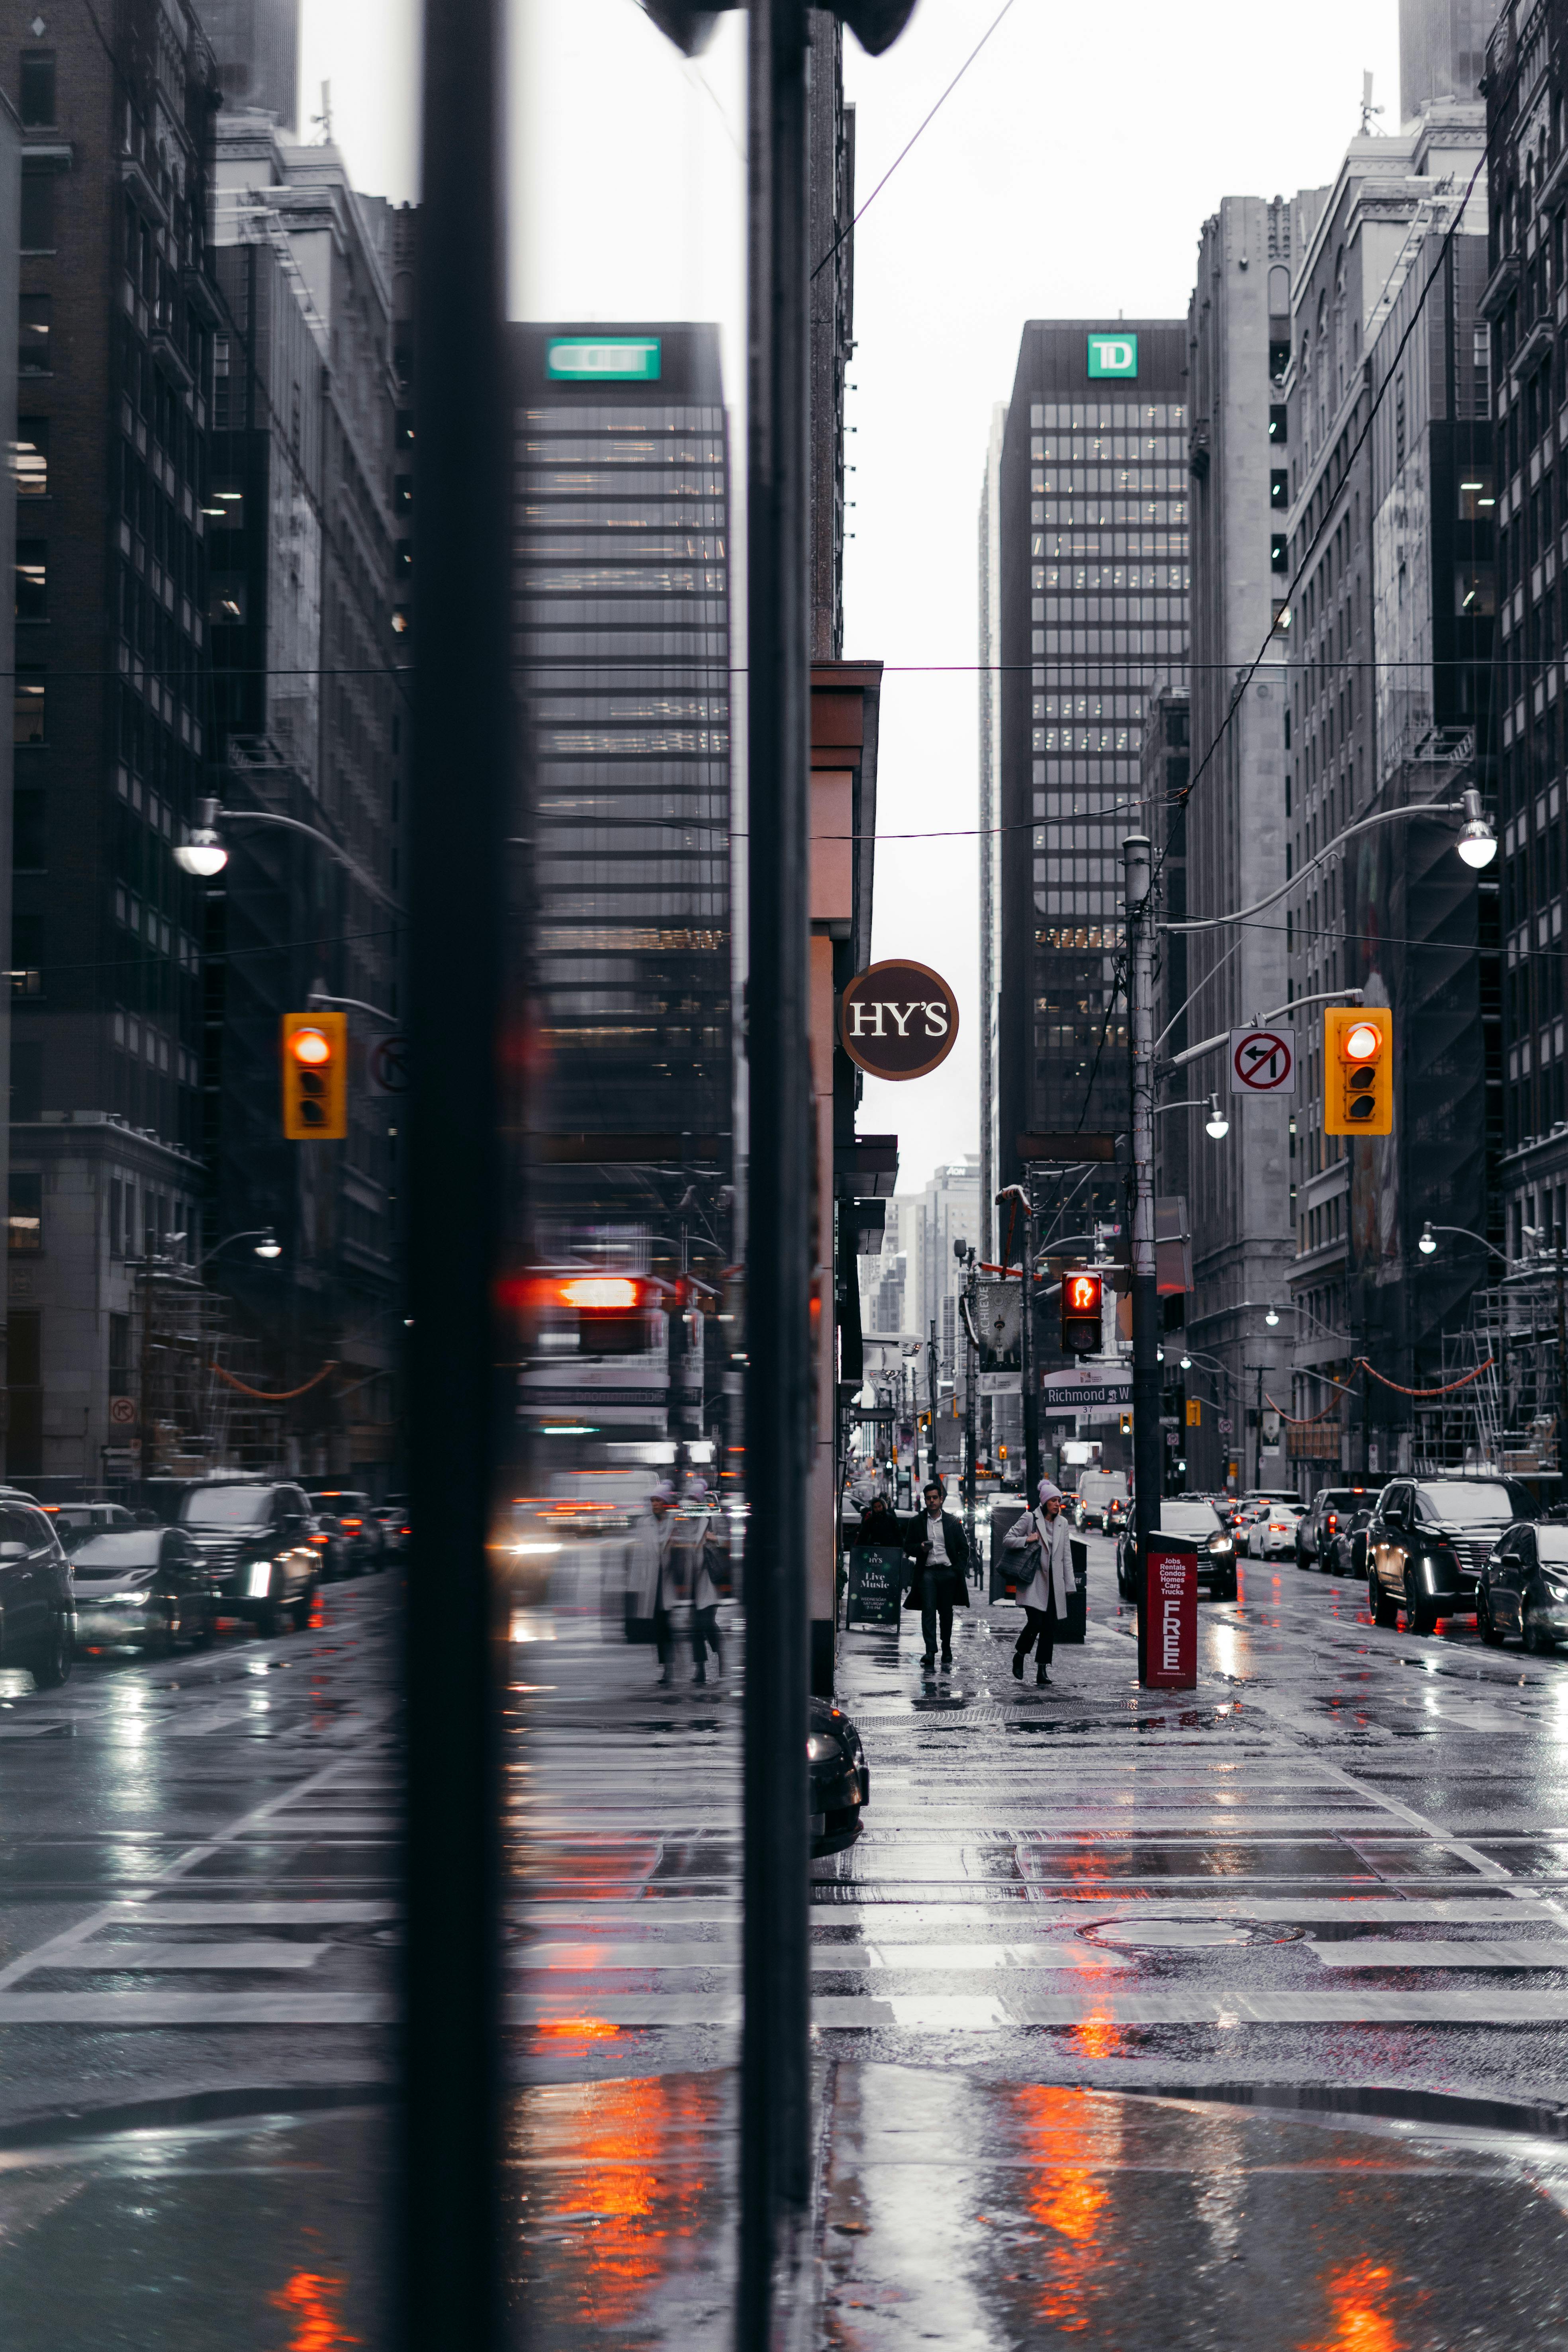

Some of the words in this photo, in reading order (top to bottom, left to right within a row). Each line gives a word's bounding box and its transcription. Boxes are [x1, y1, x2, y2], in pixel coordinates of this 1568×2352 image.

[1092, 342, 1133, 369] TD
[850, 1001, 947, 1036] HY'S
[979, 1286, 990, 1336] ACHIEVE
[1048, 1388, 1105, 1402] Richmond
[1119, 1387, 1129, 1400] W
[861, 1580, 889, 1588] Music
[865, 1572, 885, 1580] Live
[1163, 1600, 1180, 1670] FREE
